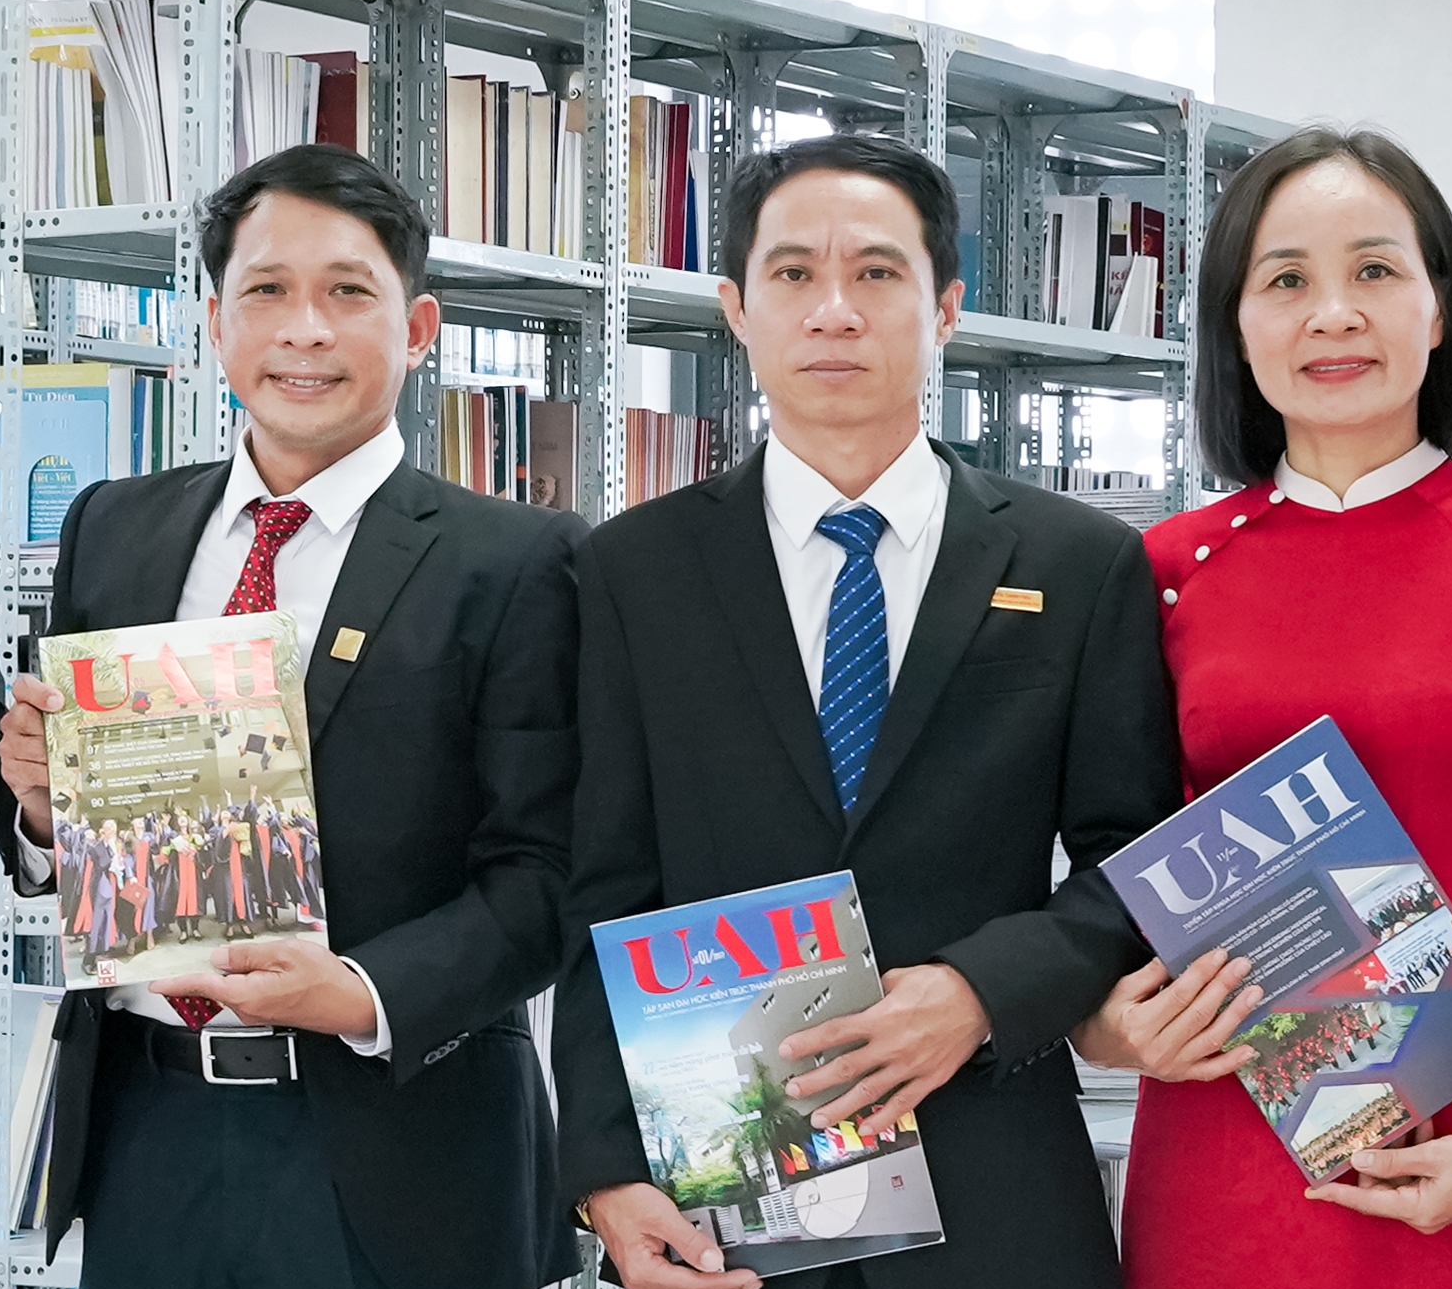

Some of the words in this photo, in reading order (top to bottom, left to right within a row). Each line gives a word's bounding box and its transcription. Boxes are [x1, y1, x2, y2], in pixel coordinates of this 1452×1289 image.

[68, 639, 282, 712] UAH
[1135, 751, 1361, 917] UAH
[622, 898, 846, 995] UAH
